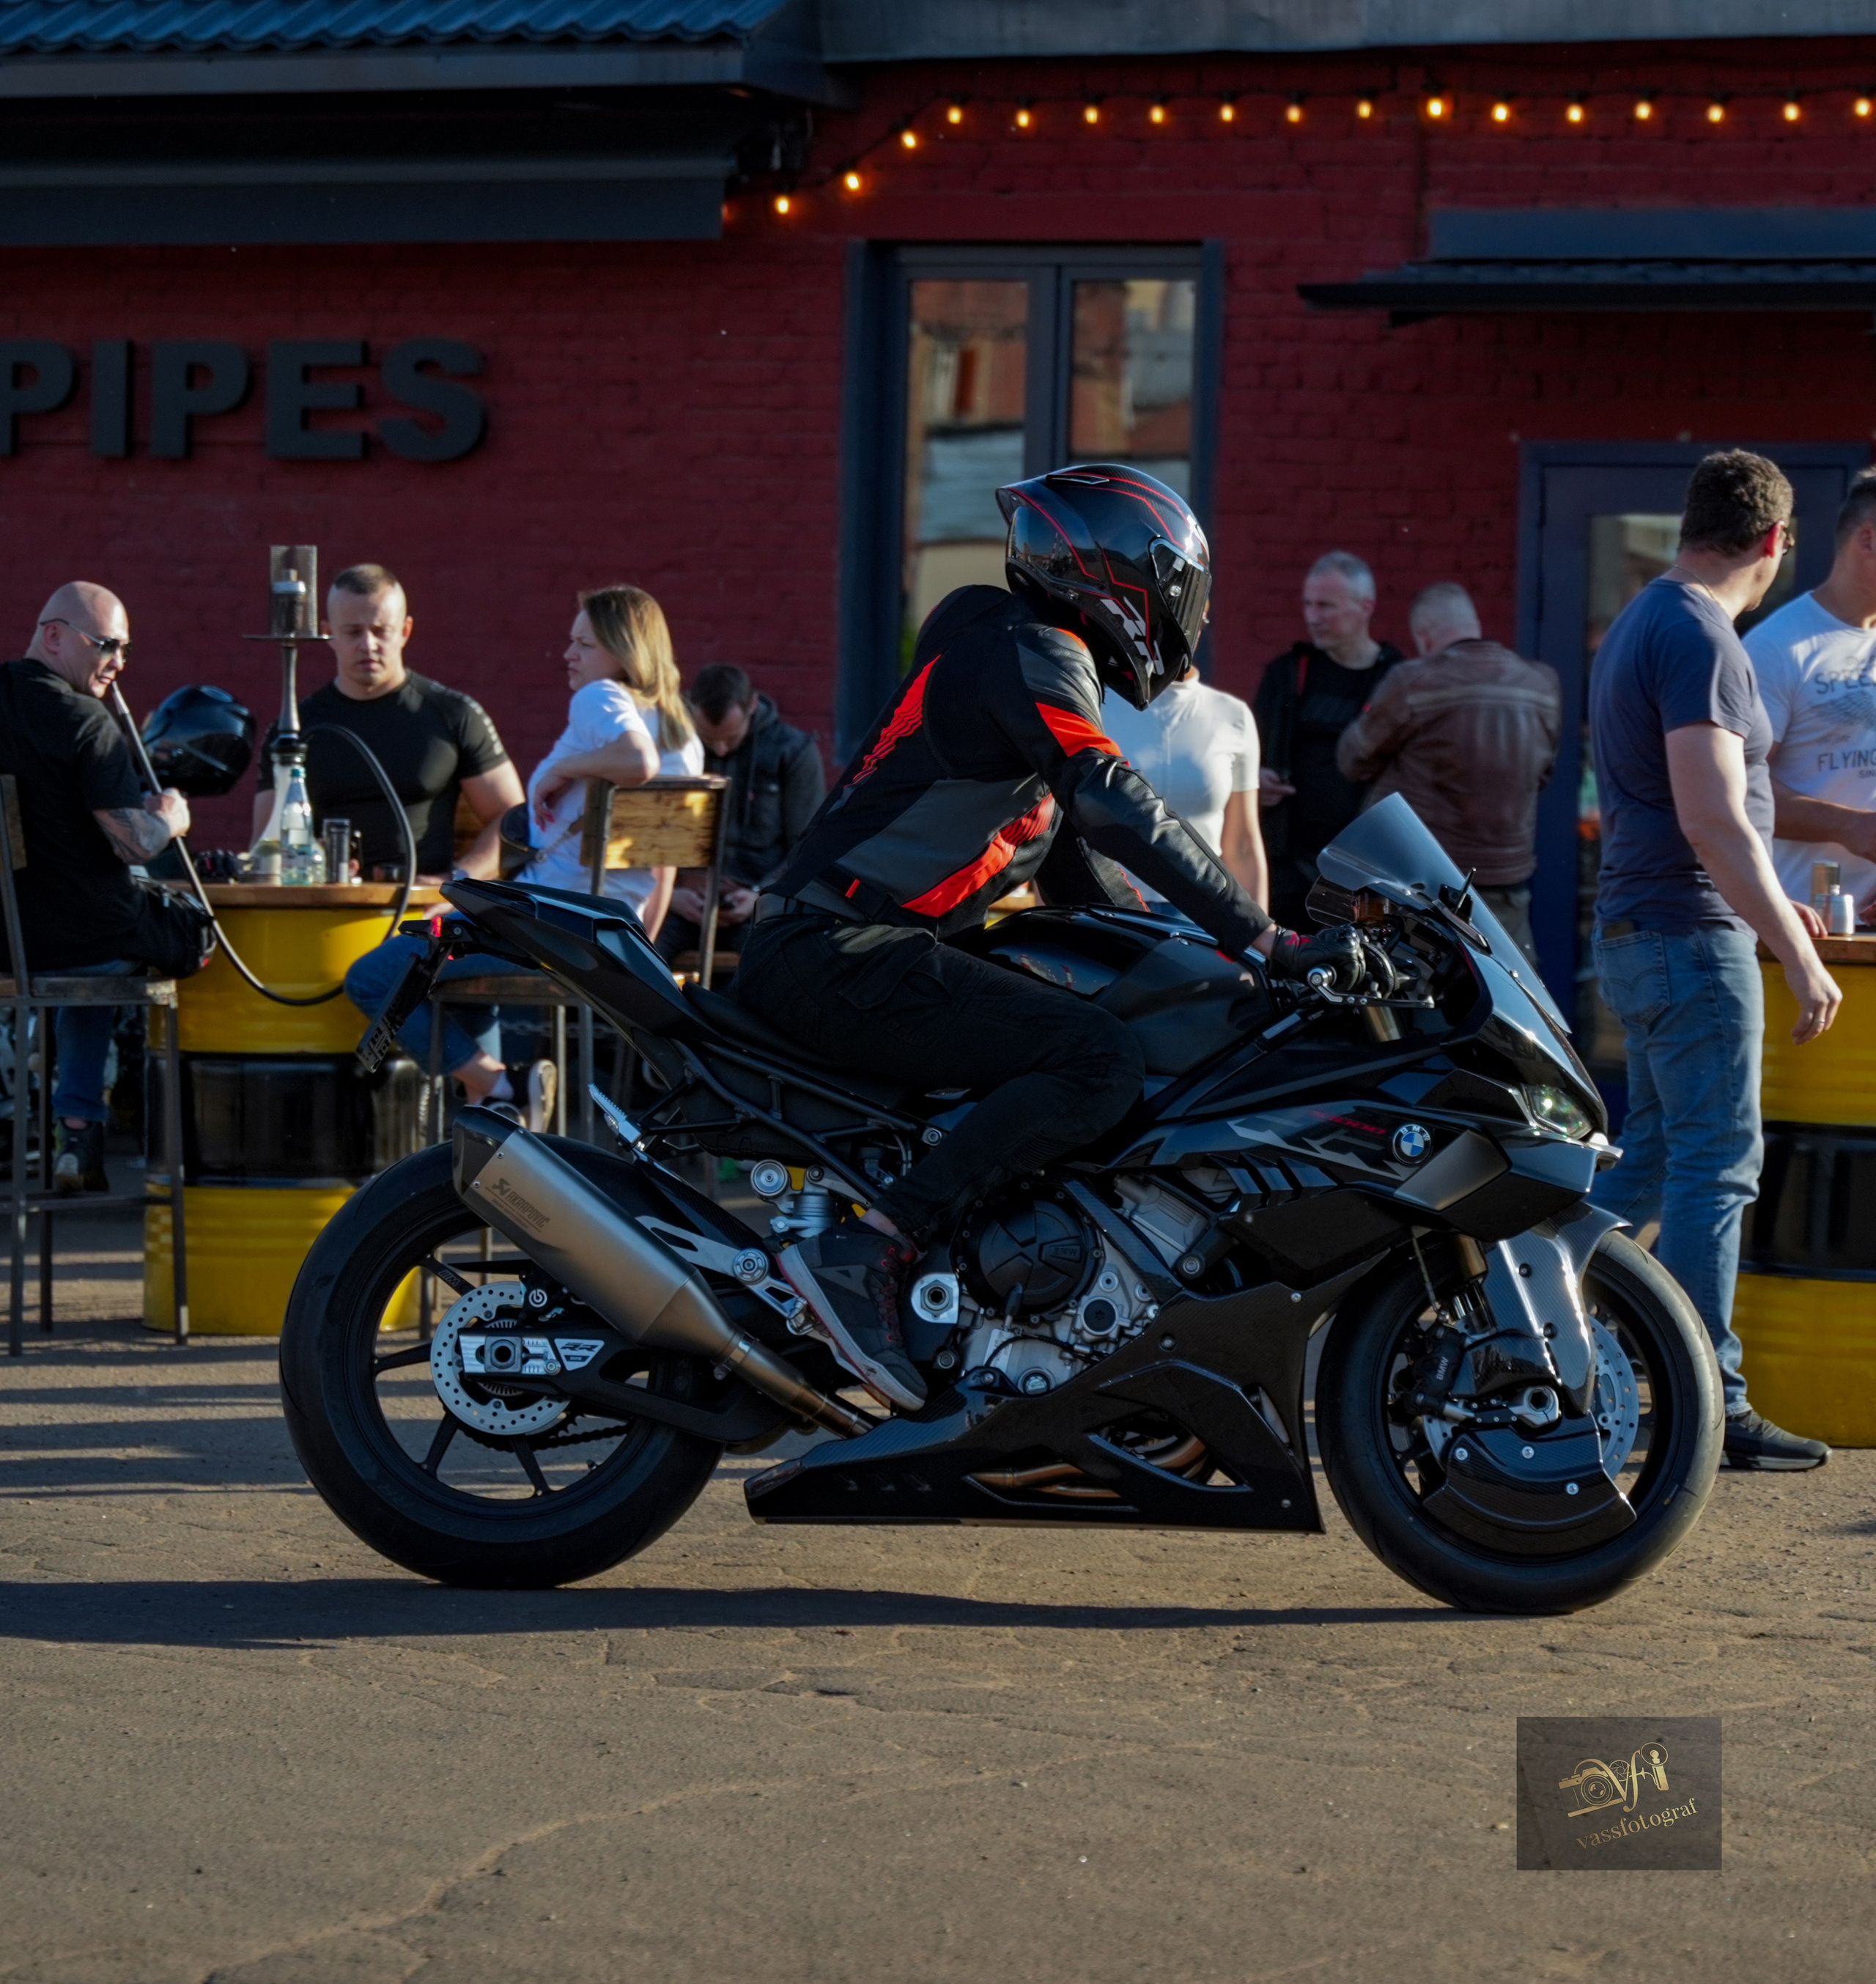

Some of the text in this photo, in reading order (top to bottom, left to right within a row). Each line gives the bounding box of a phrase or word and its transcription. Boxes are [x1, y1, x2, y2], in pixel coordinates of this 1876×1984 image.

[0, 339, 485, 461] PIPES
[1814, 664, 1876, 695] SPEE
[1399, 1124, 1430, 1142] BMW
[1435, 1356, 1450, 1381] BMW
